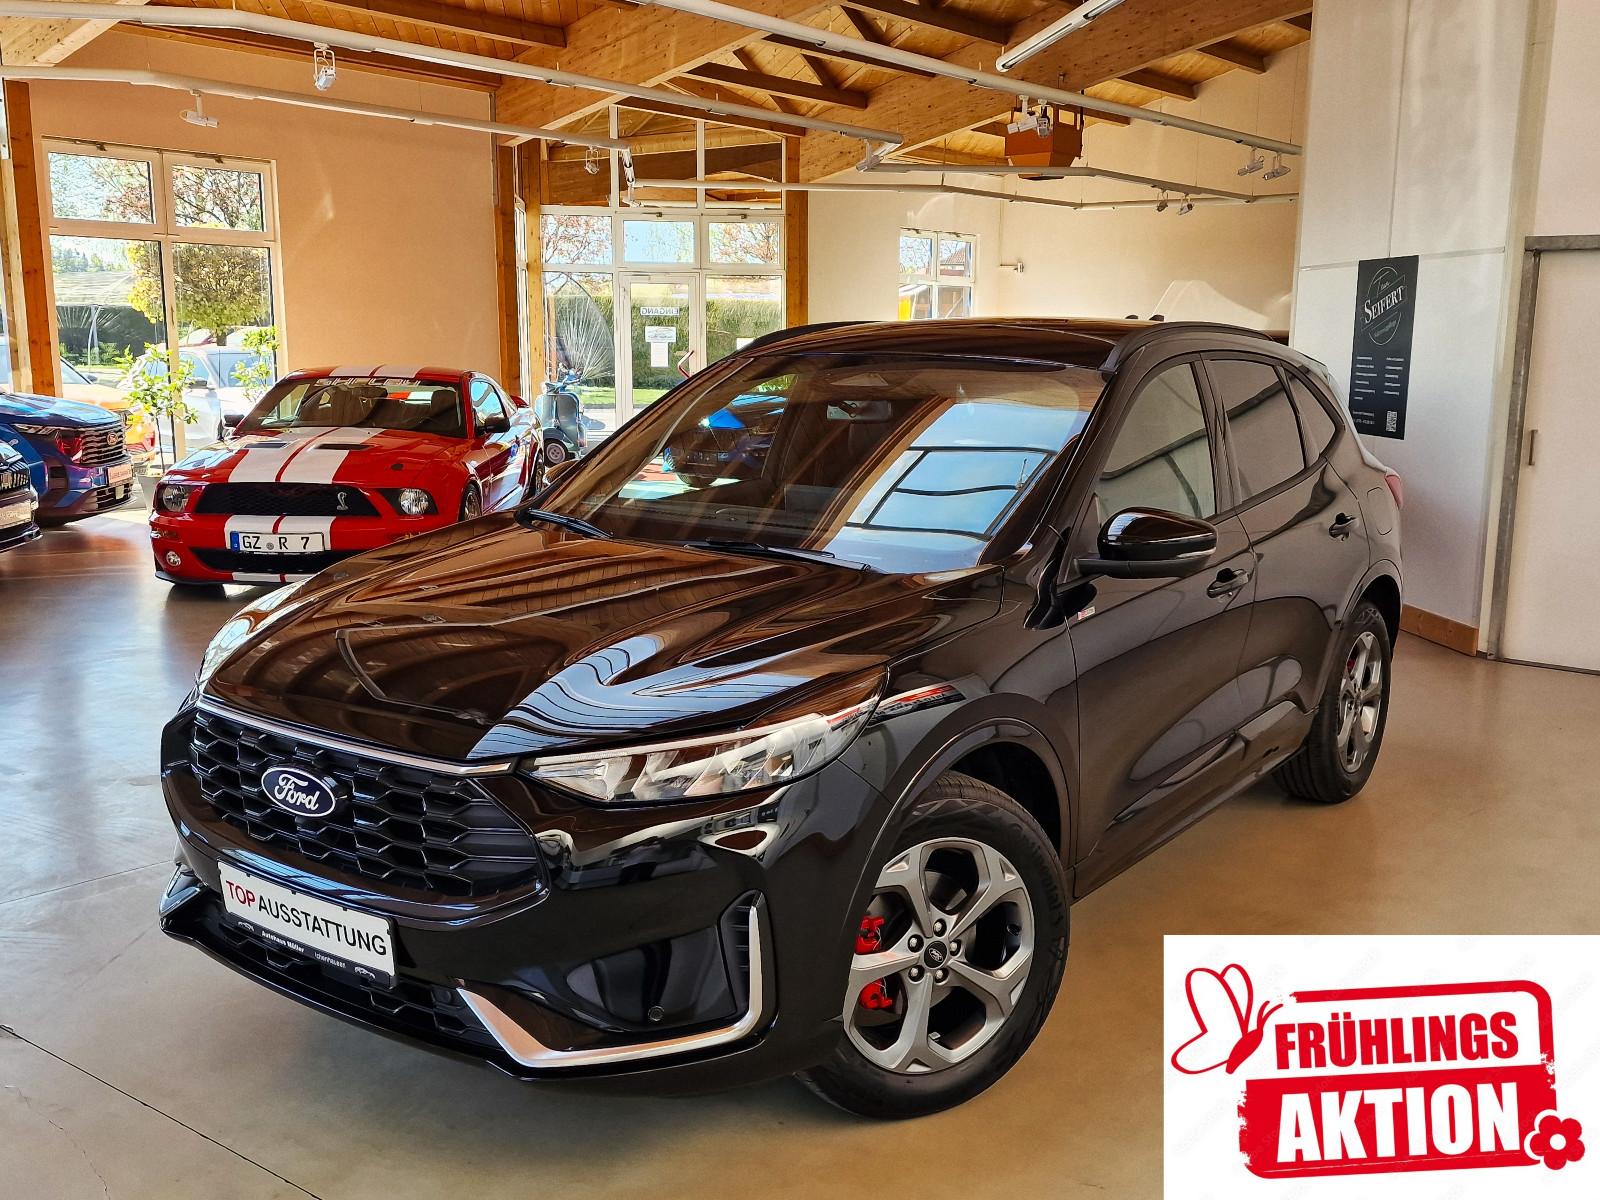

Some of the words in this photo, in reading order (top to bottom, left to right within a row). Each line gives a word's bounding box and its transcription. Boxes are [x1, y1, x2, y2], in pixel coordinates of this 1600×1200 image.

[1363, 285, 1404, 323] SEIFERT
[242, 535, 262, 549] GZ
[278, 536, 288, 550] R
[301, 536, 309, 550] 7
[274, 773, 319, 811] Ford
[225, 879, 256, 908] TOP
[258, 895, 387, 956] AUSSTATTUNG
